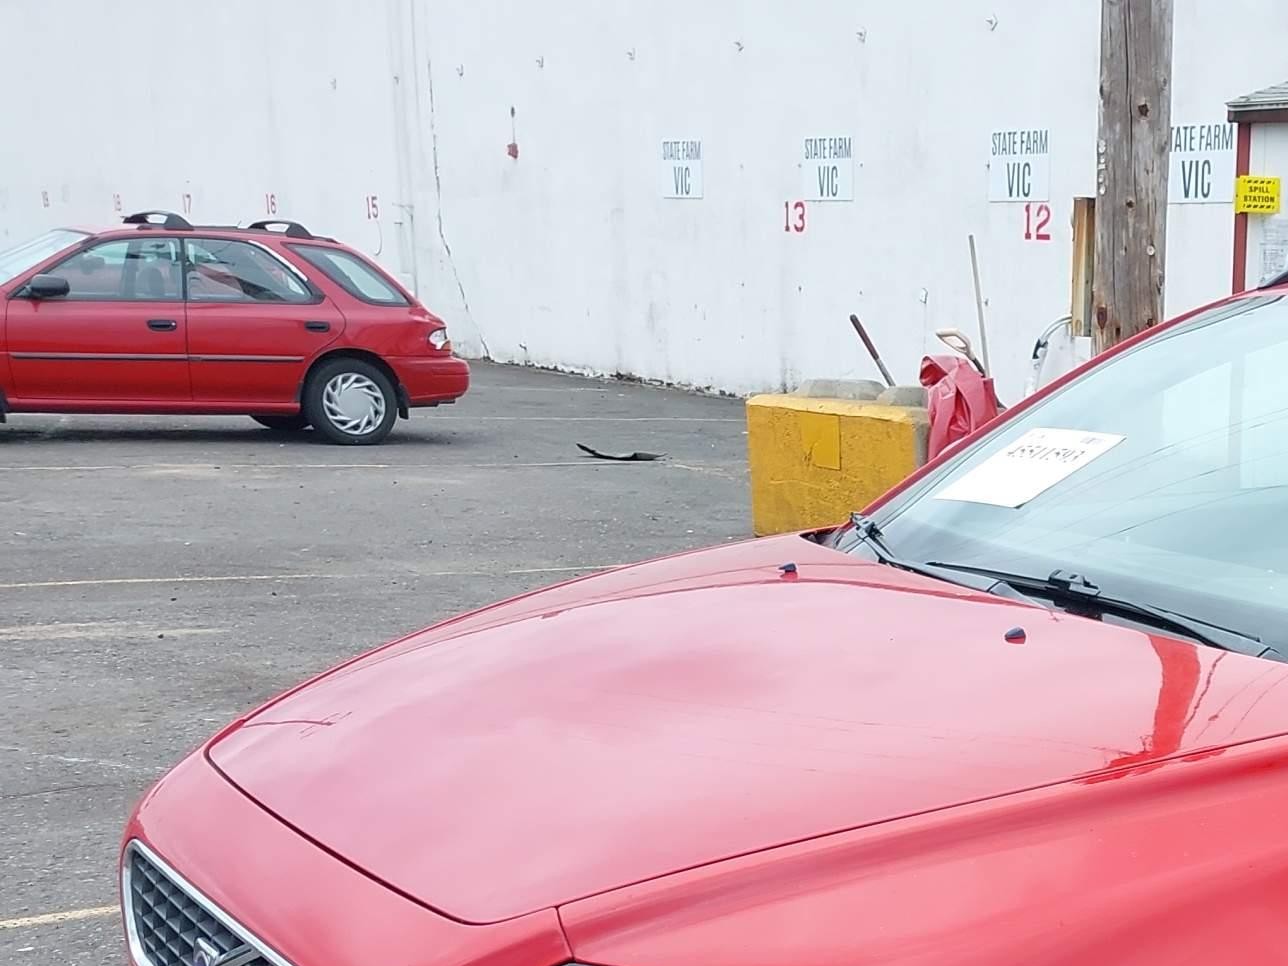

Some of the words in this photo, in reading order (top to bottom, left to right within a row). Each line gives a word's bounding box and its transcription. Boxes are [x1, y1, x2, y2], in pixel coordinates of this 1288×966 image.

[662, 141, 680, 160] STATE
[804, 138, 827, 160] STATE
[828, 137, 852, 159] FARM
[992, 131, 1018, 156] STATE
[1020, 129, 1049, 155] FARM
[1171, 126, 1196, 153] TATE
[1200, 124, 1233, 151] FARM
[673, 166, 691, 196] VIC
[817, 165, 839, 197] VIC
[1006, 162, 1032, 198] VIC
[1181, 159, 1212, 199] VIC
[1248, 186, 1271, 194] SPILL
[265, 192, 277, 215] 16
[366, 195, 379, 219] 15
[1243, 195, 1276, 203] STATION
[784, 200, 806, 233] 13
[1024, 202, 1051, 241] 12
